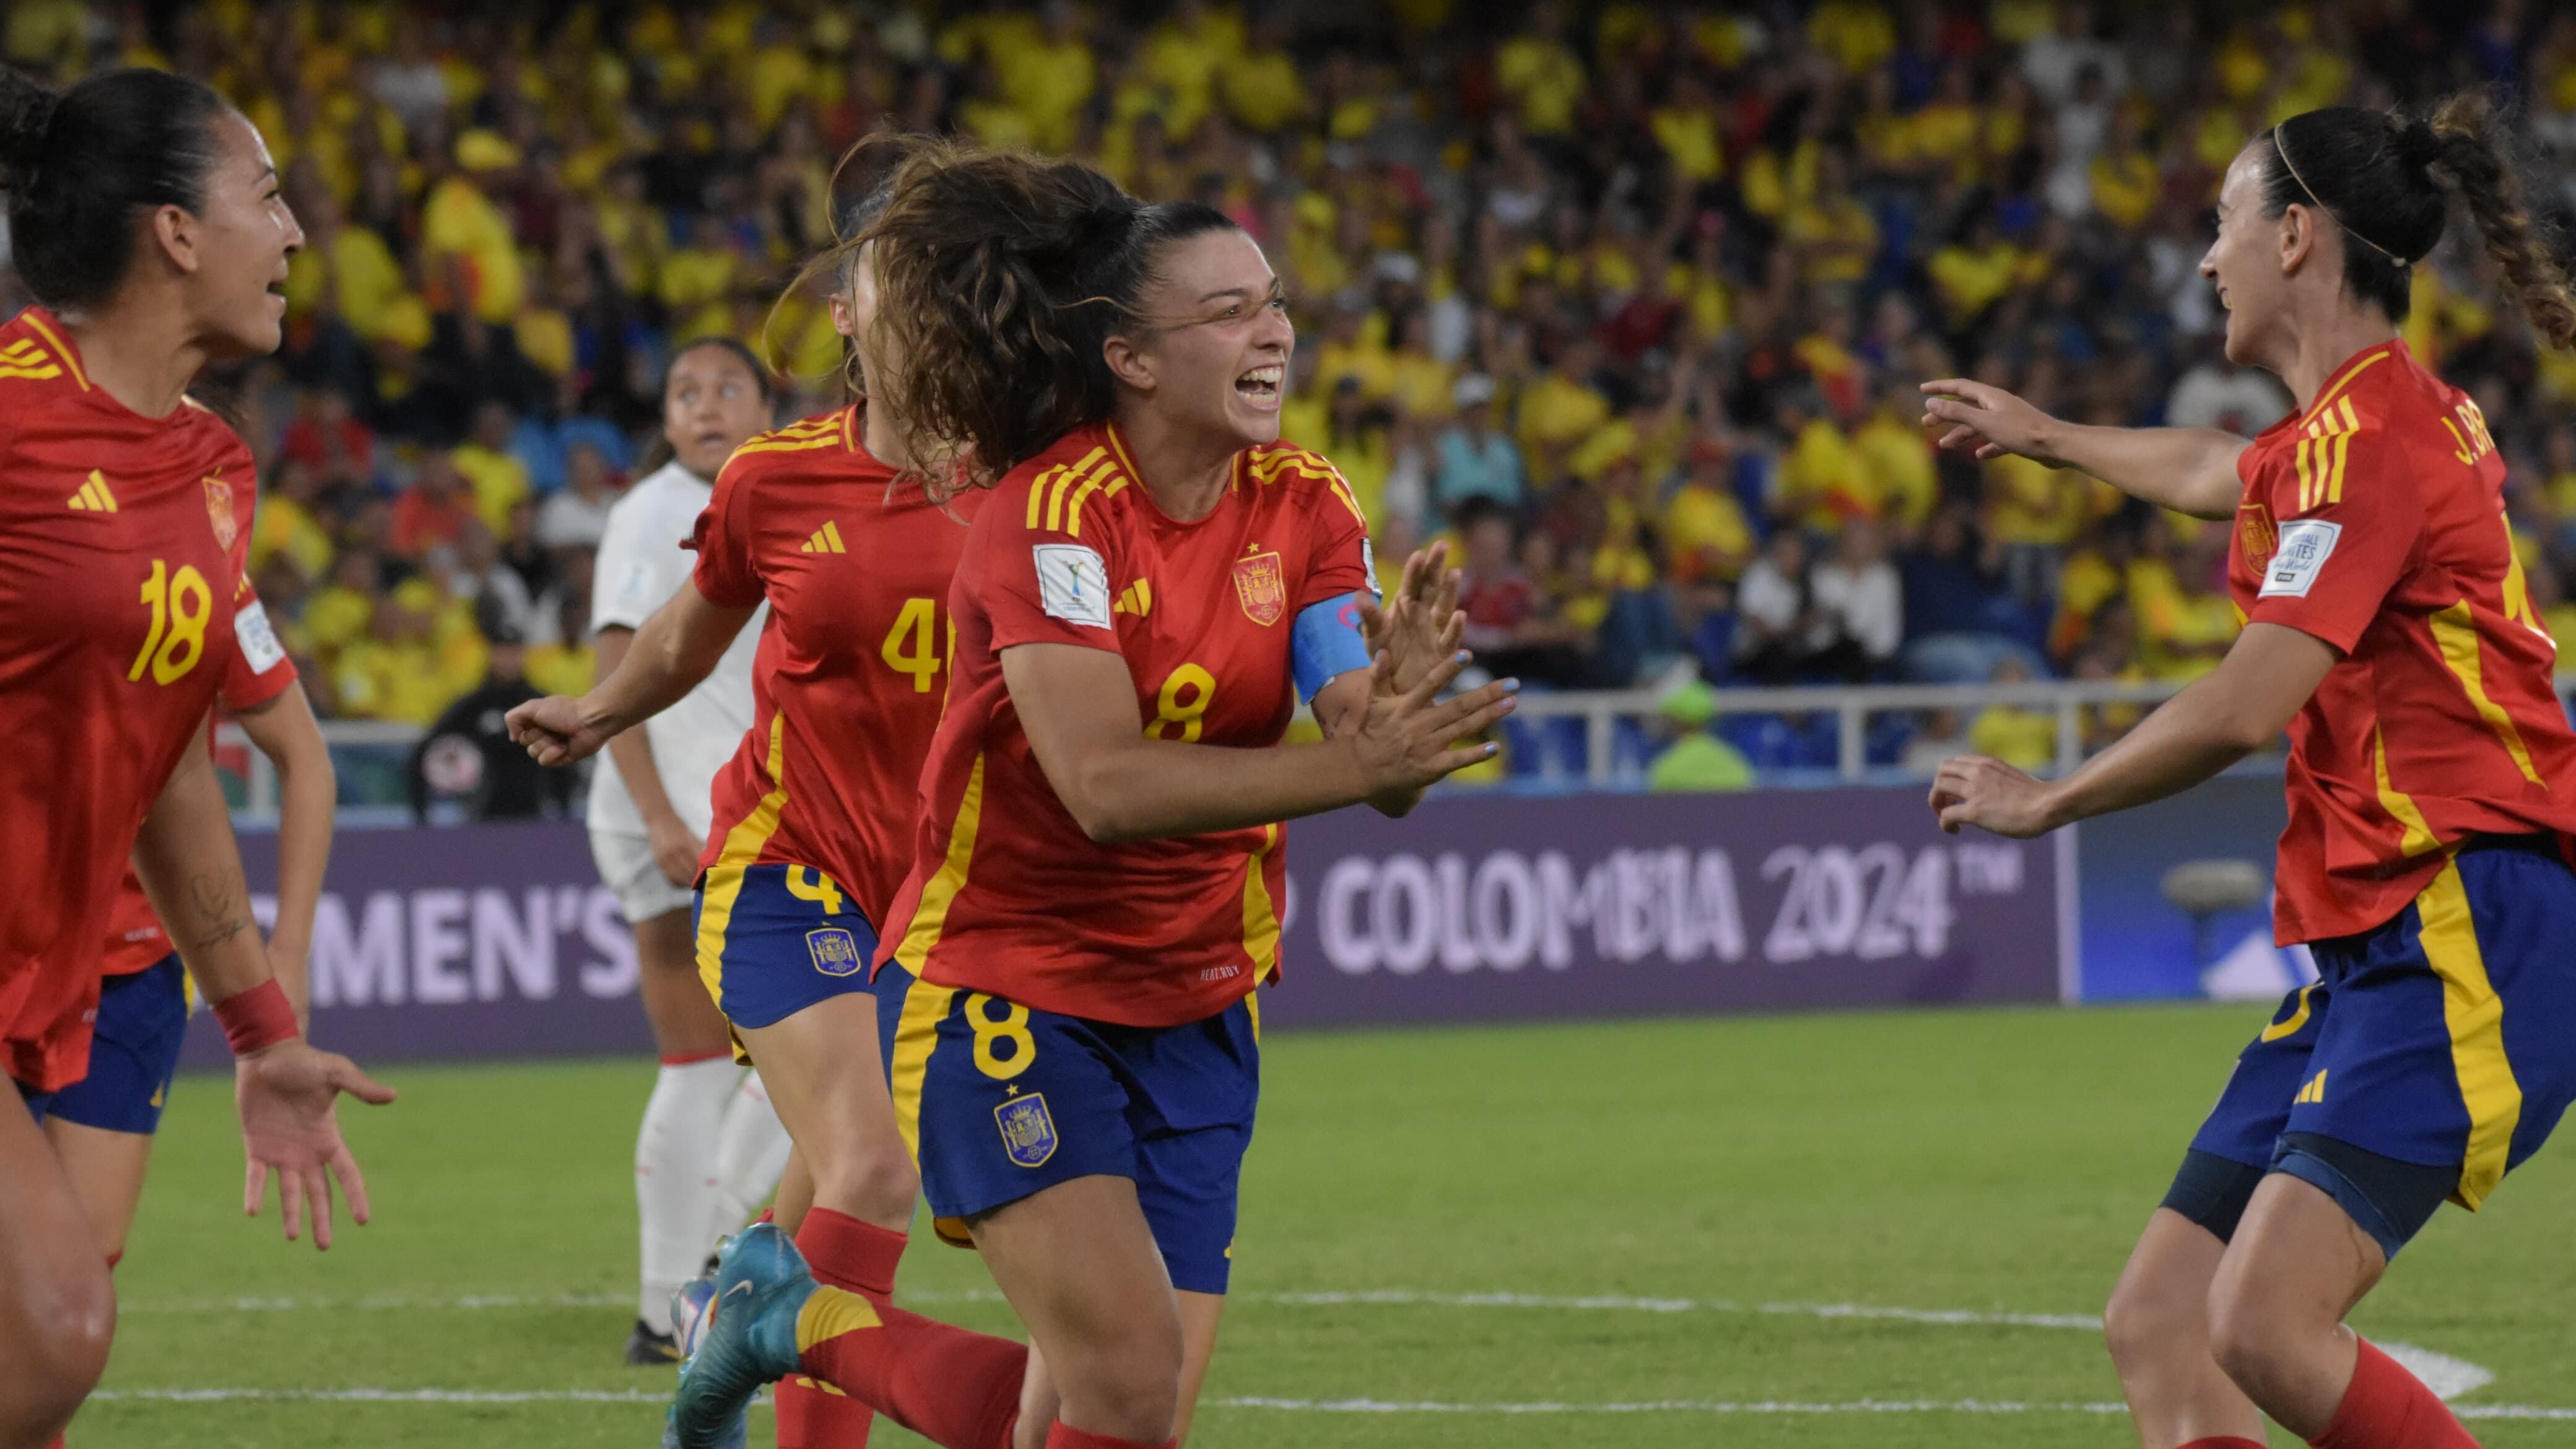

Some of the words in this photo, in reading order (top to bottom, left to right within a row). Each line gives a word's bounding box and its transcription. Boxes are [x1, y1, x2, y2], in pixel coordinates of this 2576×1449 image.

[128, 560, 212, 685] 18
[882, 598, 940, 692] 4
[1144, 663, 1216, 742] 8
[248, 884, 640, 1007] MEN'S
[1319, 847, 1746, 974] COLOMBIA
[786, 864, 842, 914] 4
[964, 993, 1035, 1080] 8
